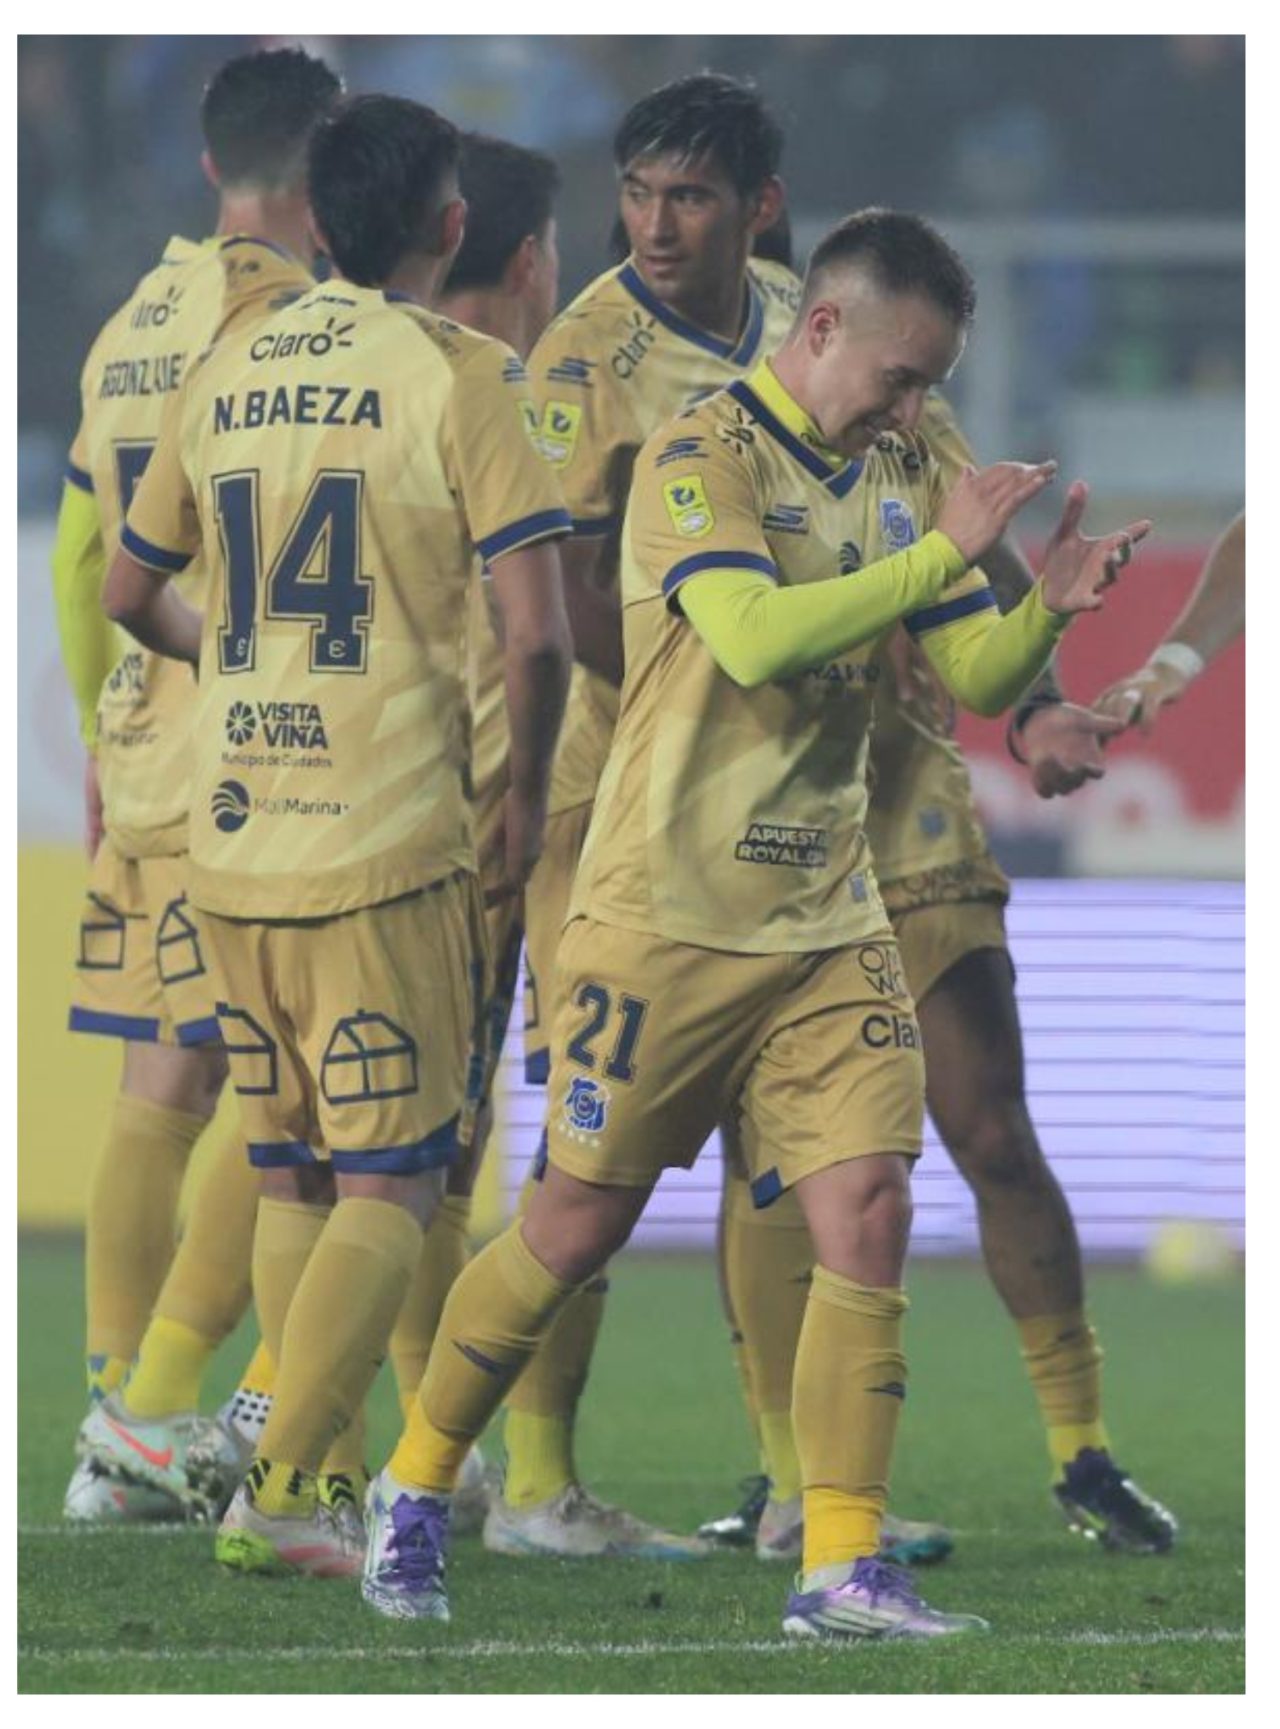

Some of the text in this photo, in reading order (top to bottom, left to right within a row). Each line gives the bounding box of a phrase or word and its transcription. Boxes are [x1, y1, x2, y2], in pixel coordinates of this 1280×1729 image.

[250, 332, 333, 362] Claro
[214, 384, 383, 435] N.BAEZA
[211, 467, 375, 673] 14
[257, 701, 322, 724] VISITA
[263, 721, 329, 751] VIÑA
[567, 983, 650, 1084] 21
[861, 1014, 918, 1049] Cla
